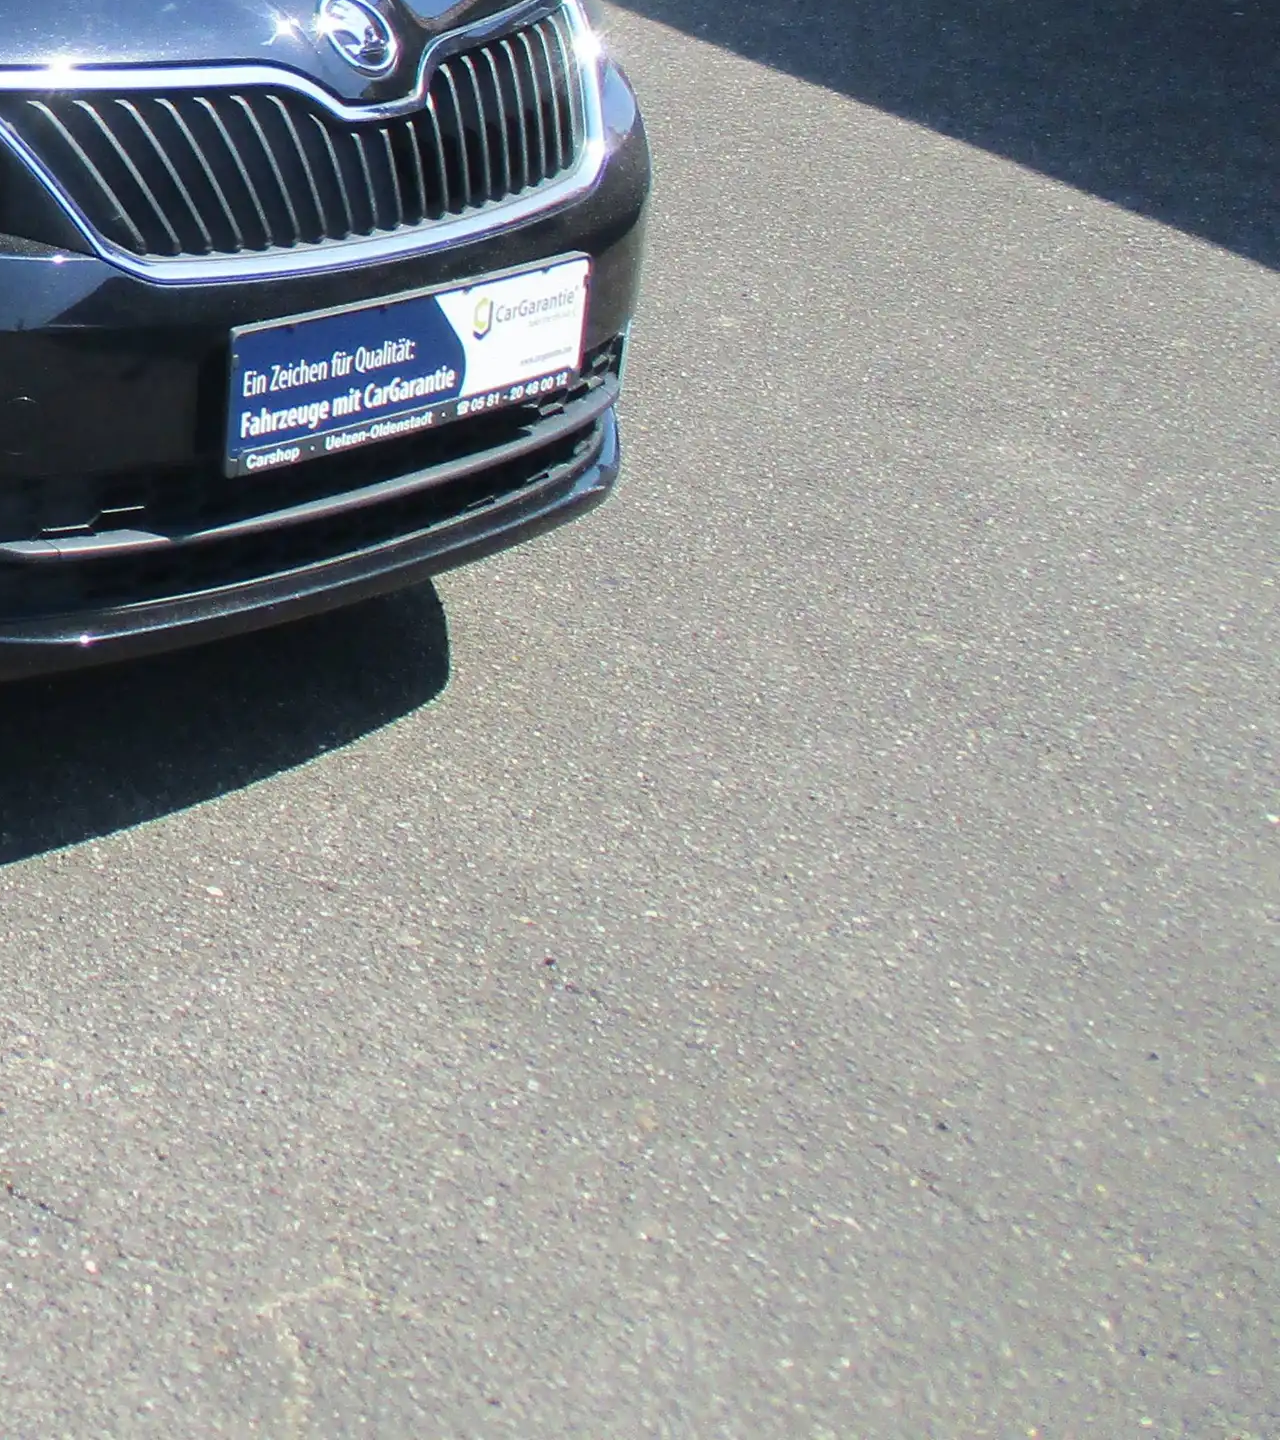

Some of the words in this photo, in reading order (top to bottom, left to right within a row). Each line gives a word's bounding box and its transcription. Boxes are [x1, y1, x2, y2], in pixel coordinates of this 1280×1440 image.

[496, 288, 575, 323] CarGarantie
[243, 370, 267, 398] Ein
[269, 360, 328, 392] Zeichen
[331, 351, 354, 378] für
[354, 338, 417, 374] Qualität:
[240, 400, 329, 439] Fahrzeuge
[333, 387, 362, 419] mit
[363, 365, 456, 409] CarGarantie
[246, 446, 301, 470] Carshop
[324, 410, 434, 451] Uelzen-Oldenstadt
